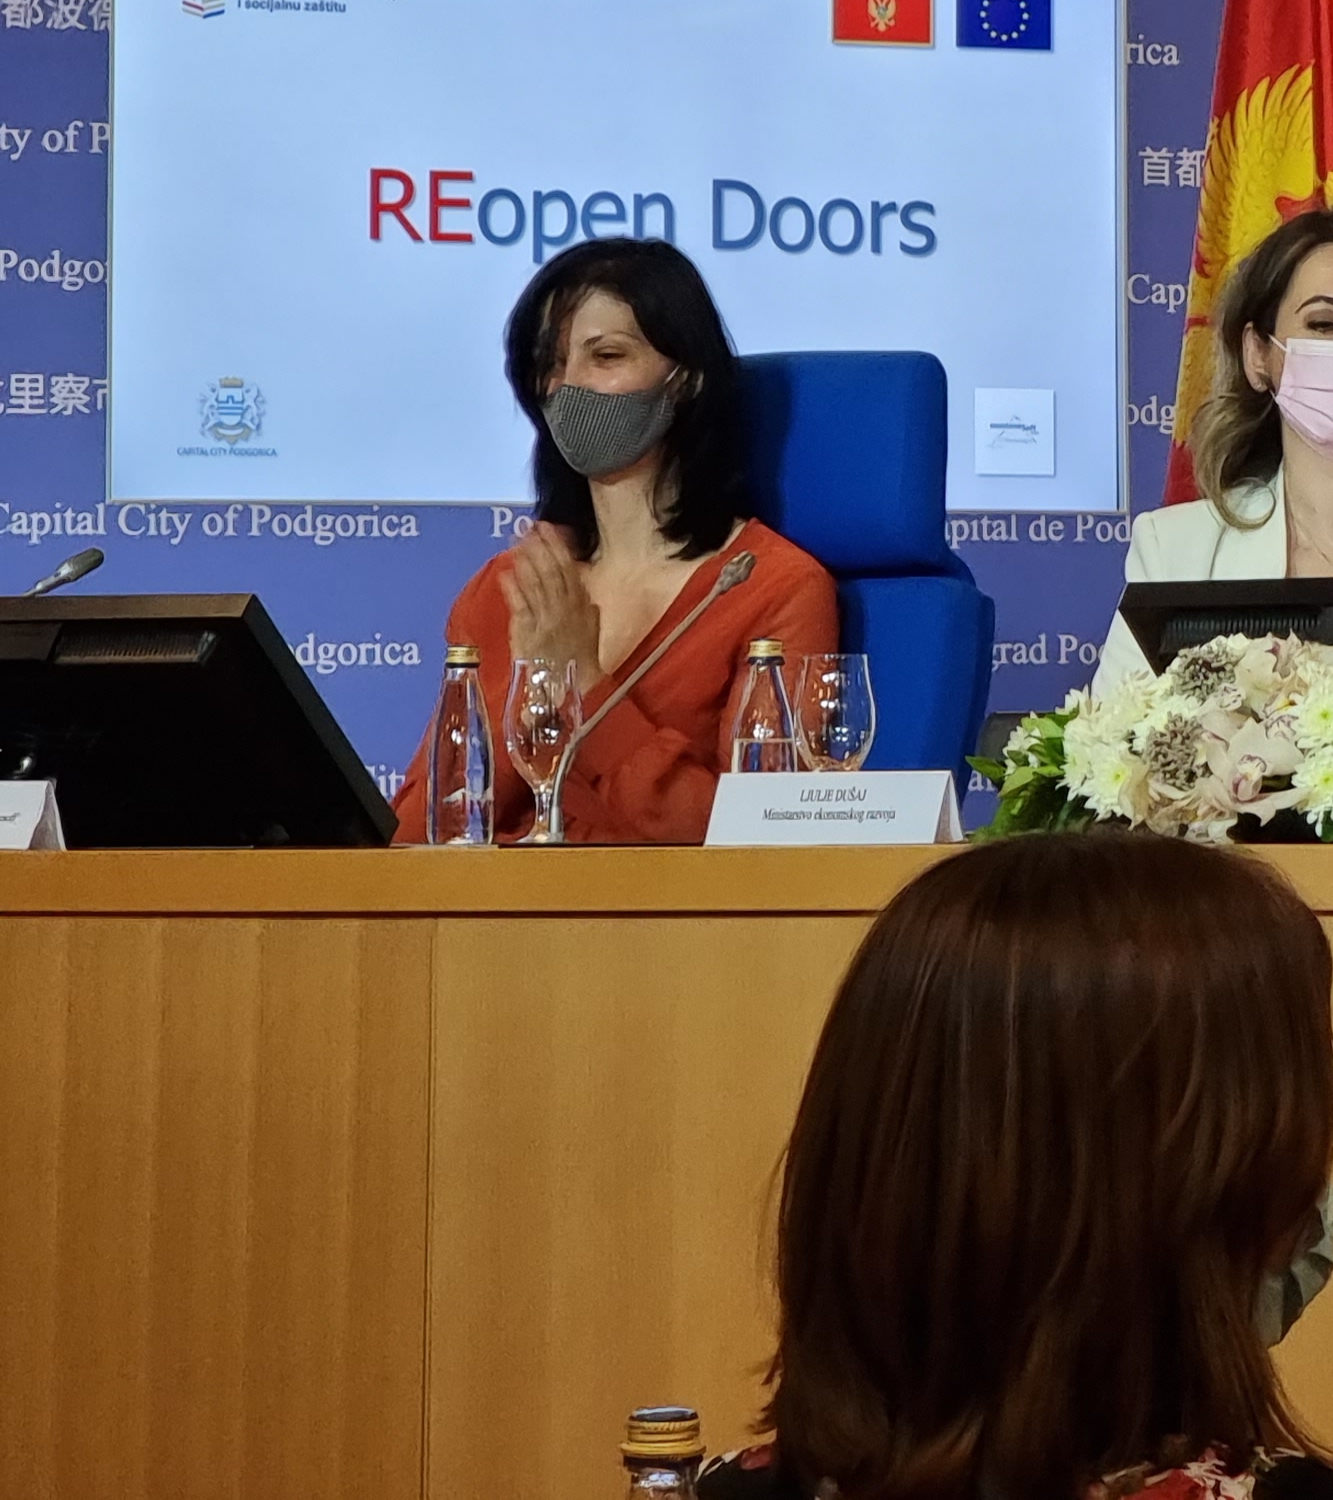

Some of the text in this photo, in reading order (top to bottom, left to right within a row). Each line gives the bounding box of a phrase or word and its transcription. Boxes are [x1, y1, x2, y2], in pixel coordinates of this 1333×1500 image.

[304, 0, 346, 13] zaštitu
[41, 120, 83, 153] of
[369, 167, 938, 263] REopen Doors
[117, 503, 191, 545] City
[202, 505, 243, 538] of
[249, 505, 419, 545] Podgorica
[1028, 514, 1065, 542] de
[288, 632, 422, 675] dgorica
